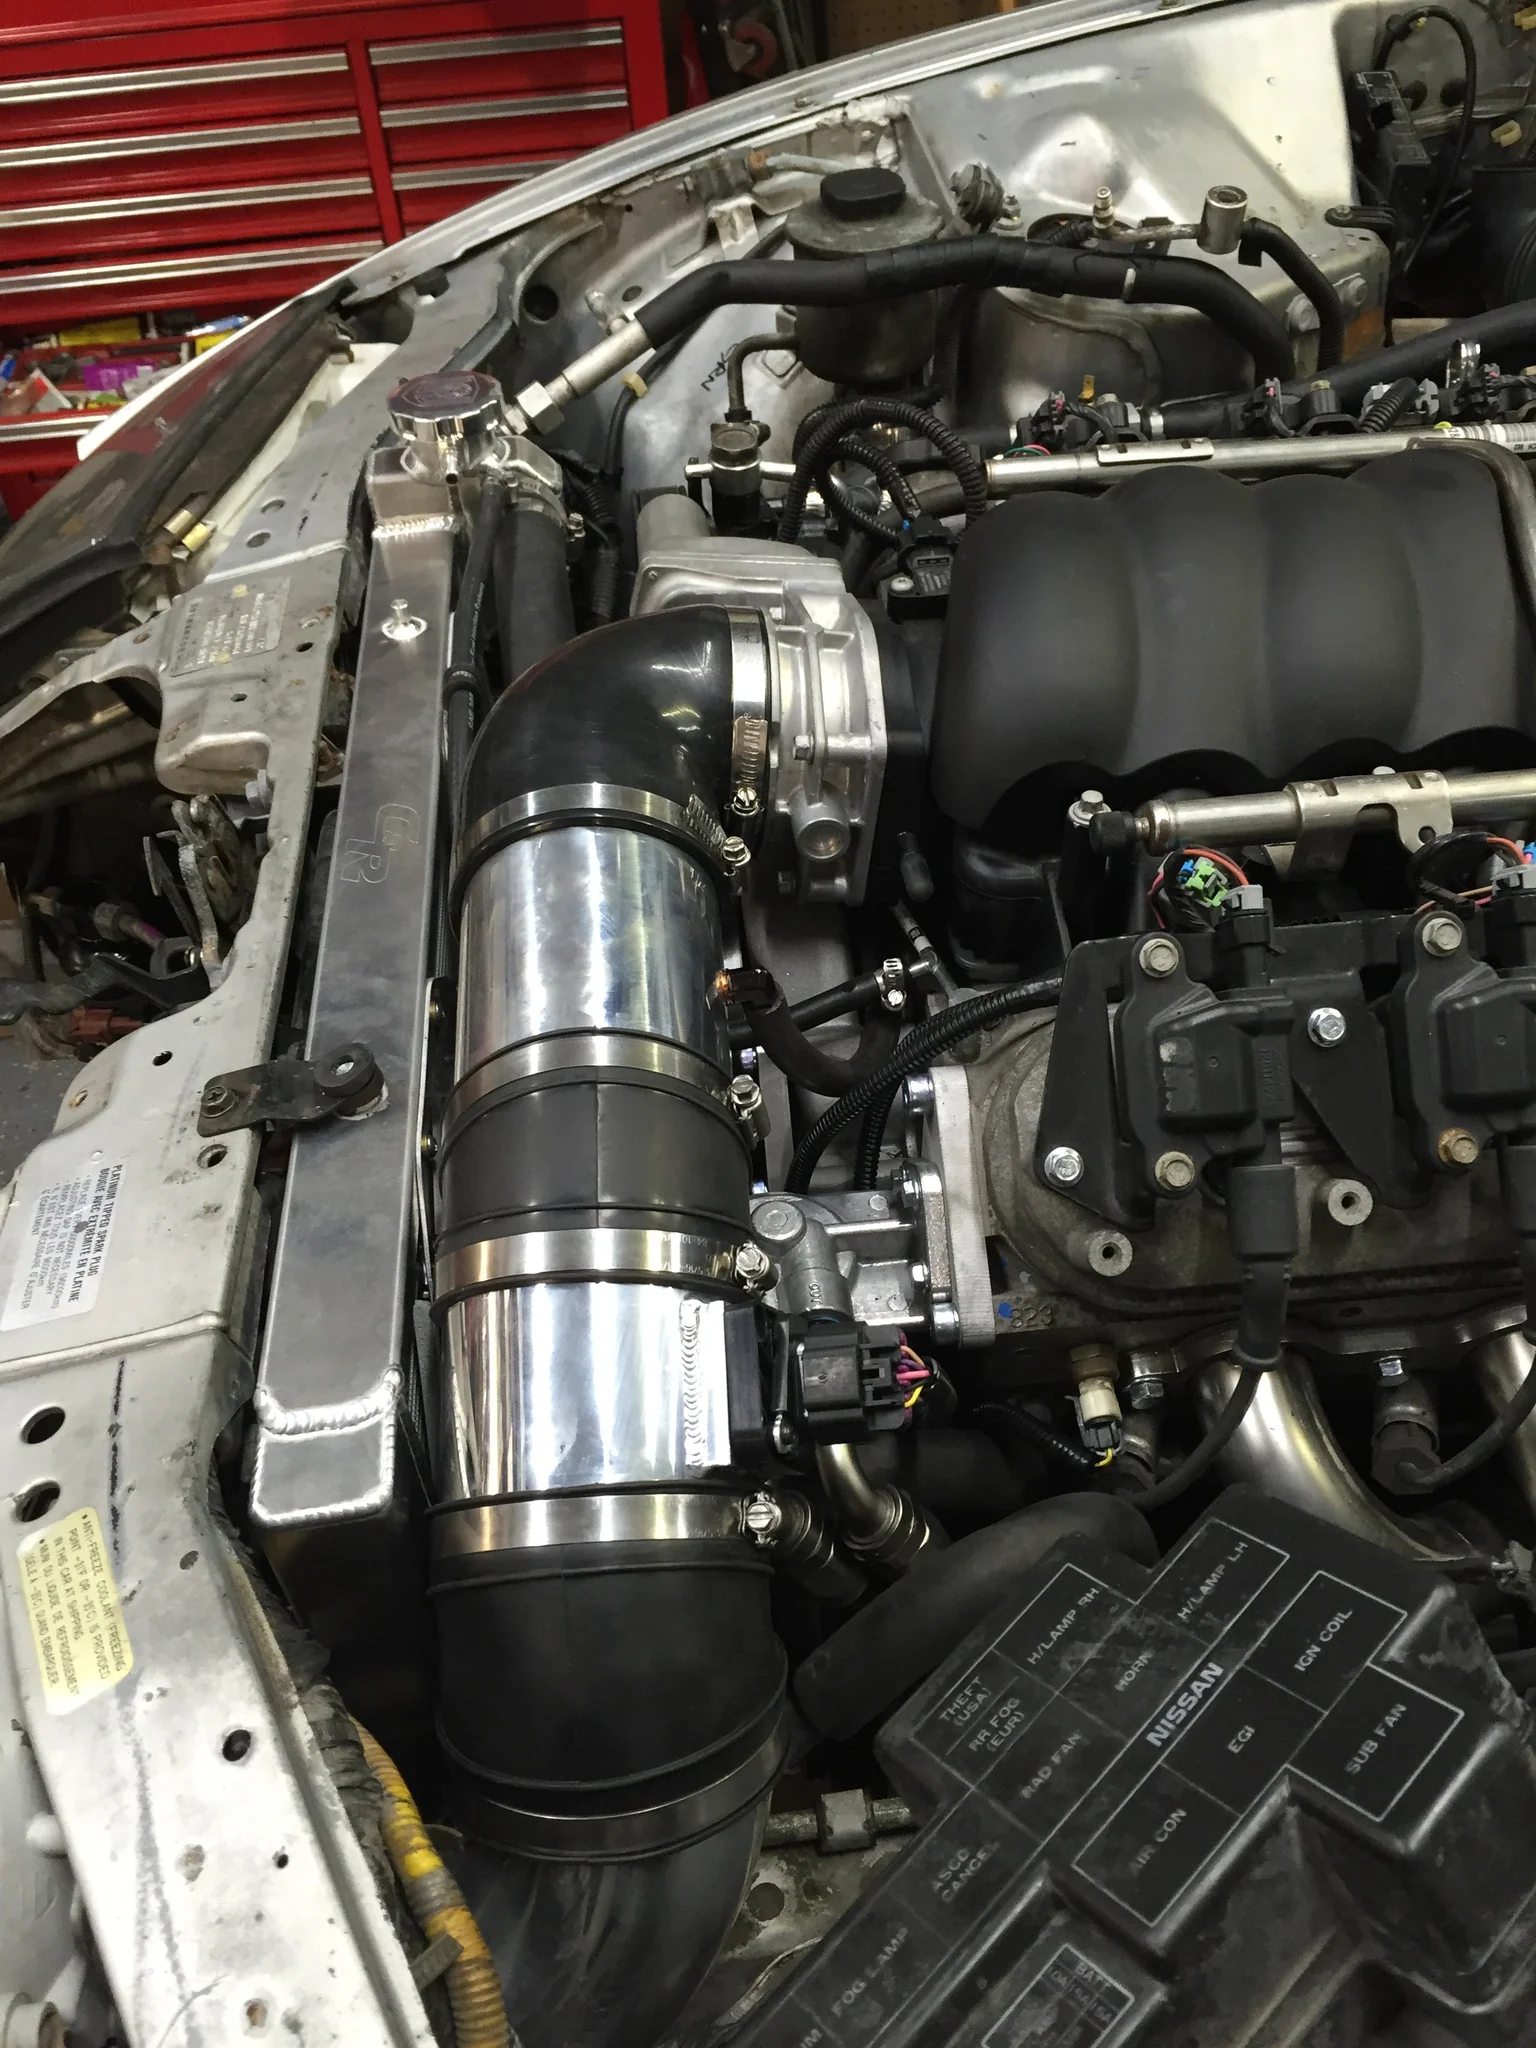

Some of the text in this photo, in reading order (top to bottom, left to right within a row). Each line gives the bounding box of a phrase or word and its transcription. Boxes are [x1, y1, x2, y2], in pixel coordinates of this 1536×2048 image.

[87, 1164, 123, 1275] PLATINUM TIPPED SPARK PLUG
[89, 1195, 103, 1212] AVEC
[76, 1258, 88, 1267] EN
[68, 1271, 85, 1301] PLATINE
[809, 1282, 822, 1304] OUT
[55, 1546, 68, 1566] THIS
[59, 1566, 72, 1585] CAR
[80, 1519, 104, 1576] ANTI-FREEZE
[95, 1579, 114, 1620] COOLANT
[64, 1585, 75, 1599] AT
[67, 1527, 81, 1553] POINT
[79, 1577, 90, 1592] OR
[91, 1633, 111, 1679] PROVIDED
[1177, 1541, 1249, 1621] H/LAMP LH
[1027, 1587, 1100, 1665] H/LAMP RH
[1294, 1610, 1353, 1672] IGN COIL
[1114, 1651, 1153, 1692] HORN
[939, 1676, 982, 1722] THEFT
[953, 1687, 992, 1727] (USA)
[1146, 1662, 1224, 1748] NISSAN
[968, 1697, 1021, 1752] RR FOG
[986, 1711, 1025, 1752] (EUR)
[1227, 1725, 1256, 1754] EGI
[1344, 1703, 1408, 1775] SUB FAN
[1019, 1730, 1083, 1800] RAD FAN
[1129, 1808, 1188, 1876] AIR CON
[932, 1848, 970, 1893] ASCD
[830, 1927, 908, 2018] FOG LAMP
